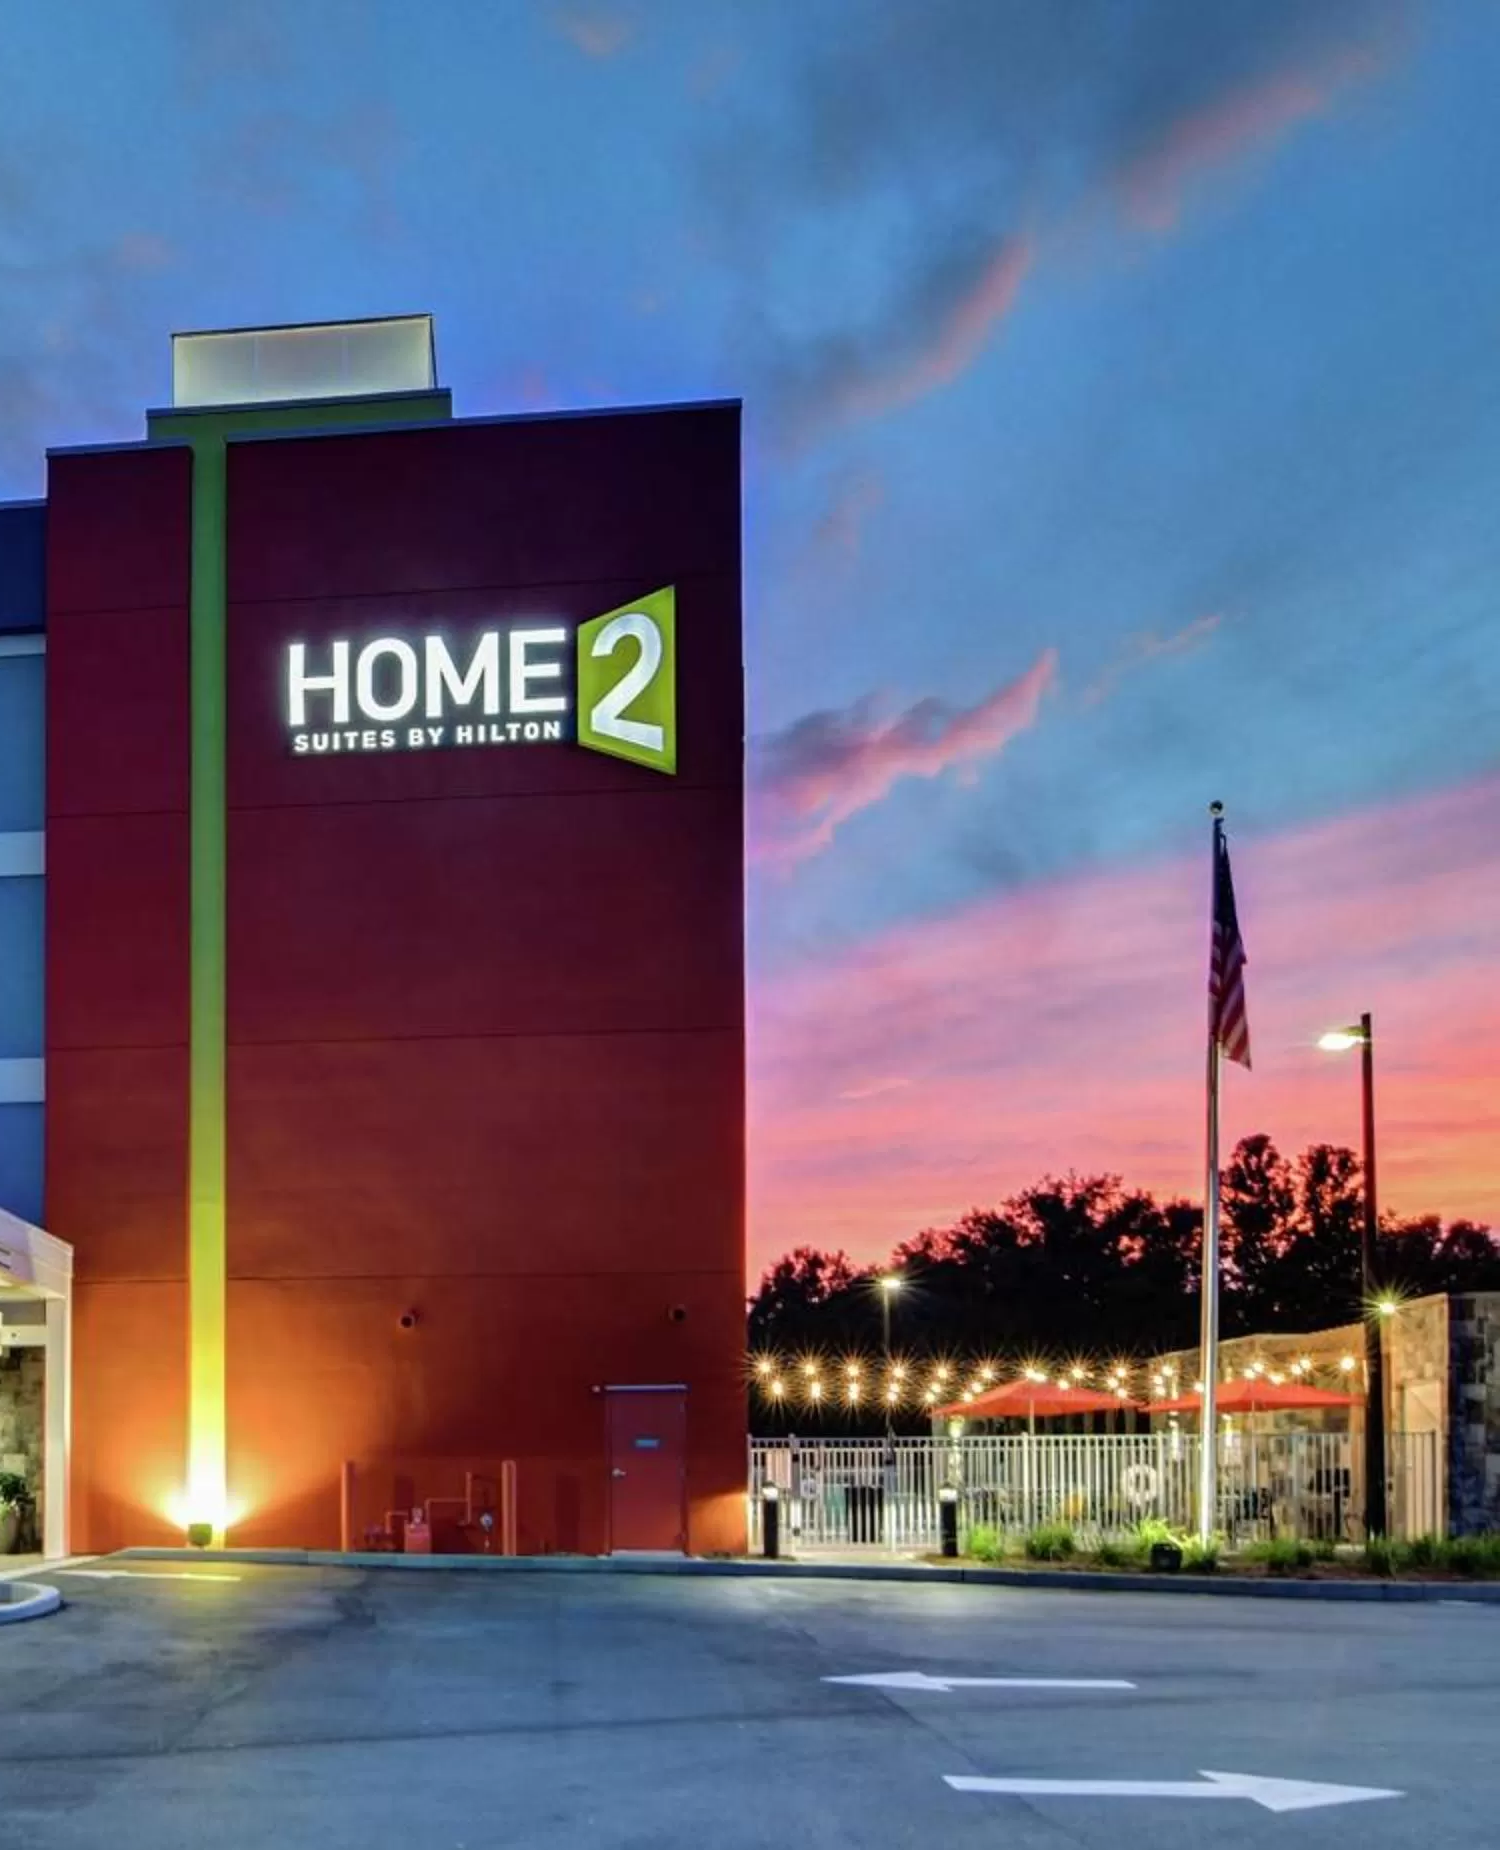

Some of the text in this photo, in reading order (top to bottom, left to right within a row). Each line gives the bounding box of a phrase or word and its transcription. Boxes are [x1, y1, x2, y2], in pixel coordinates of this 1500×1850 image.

[289, 612, 664, 752] HOME 2
[294, 721, 561, 752] SUITES BY HILTON
